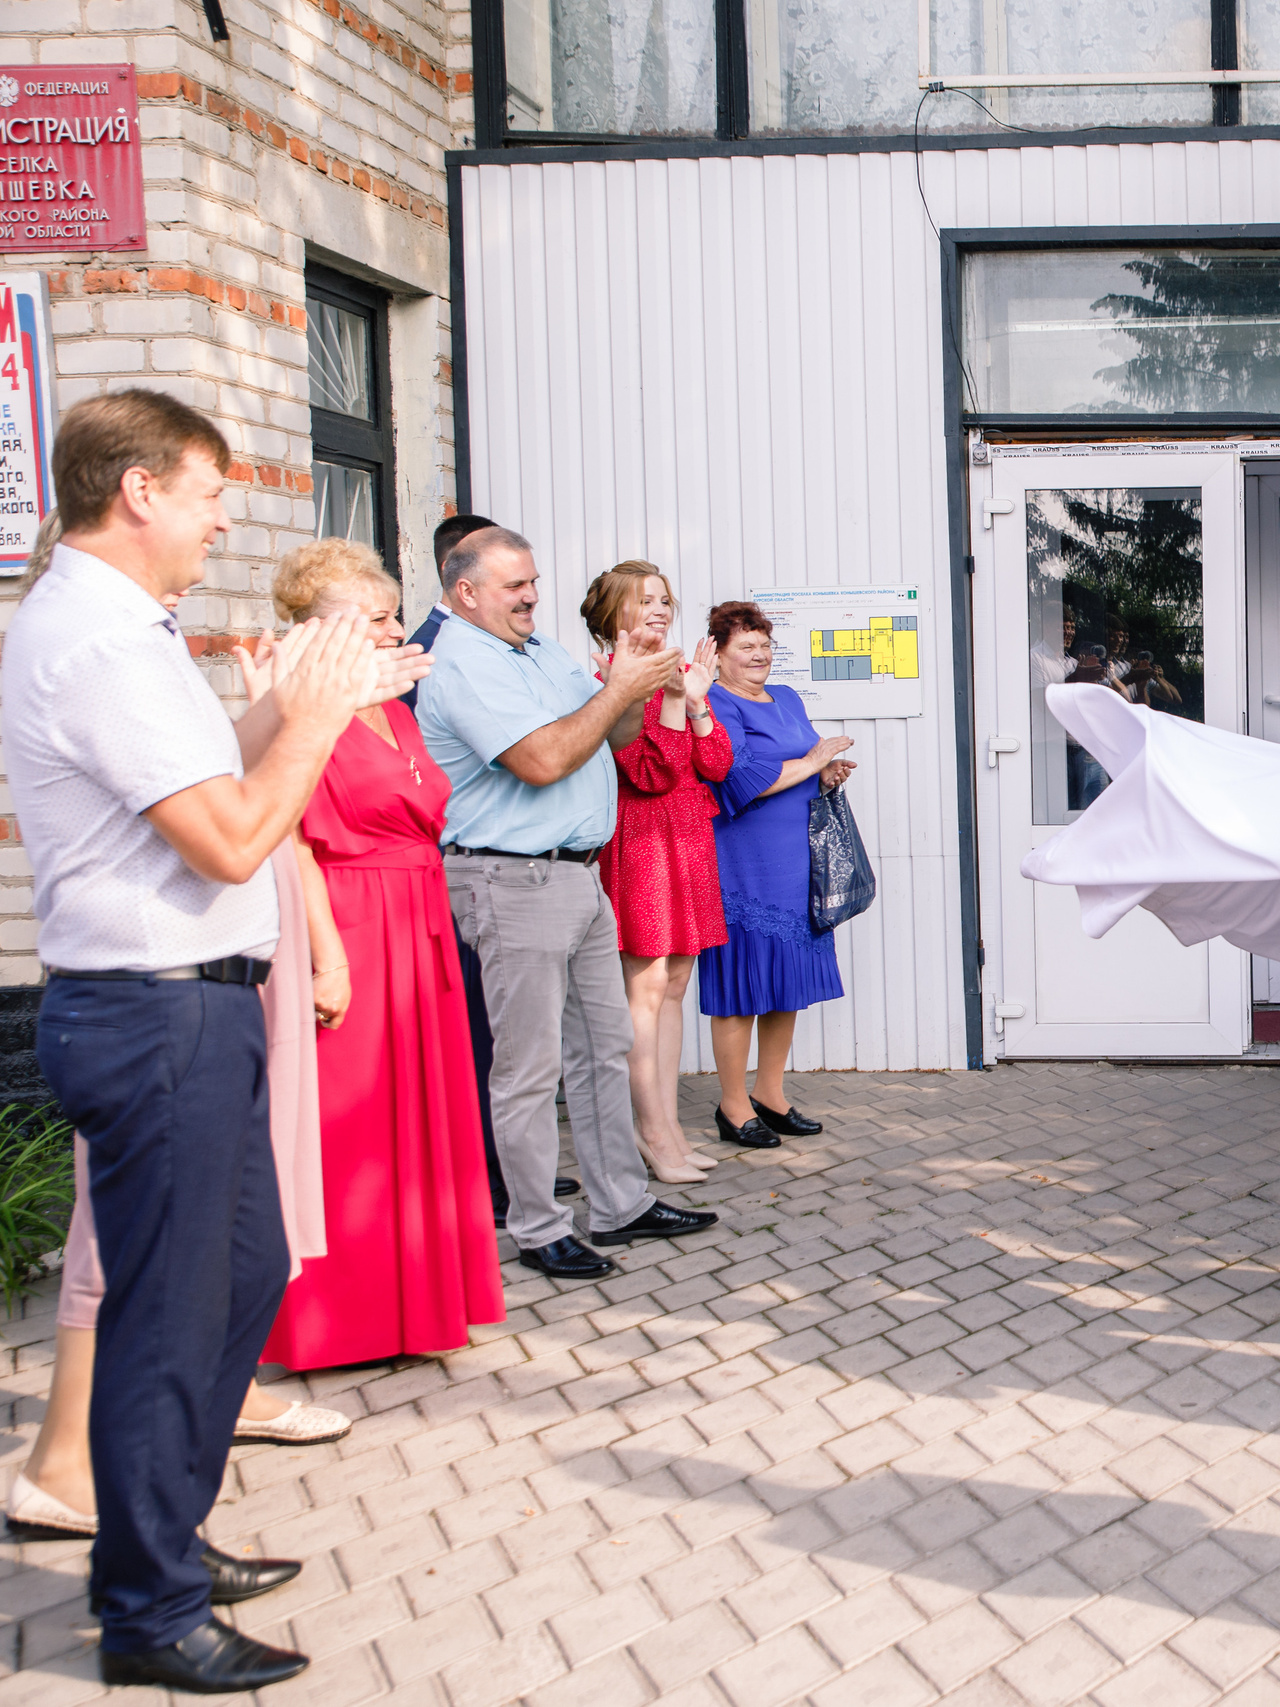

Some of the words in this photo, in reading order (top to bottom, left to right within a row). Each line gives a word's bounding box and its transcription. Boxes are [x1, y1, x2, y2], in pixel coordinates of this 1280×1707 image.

[24, 81, 109, 96] ФЕДЕРАЦИЯ
[52, 206, 110, 221] РАЙОНА
[25, 225, 91, 238] ОБЛАСТИ
[0, 501, 37, 515] КОГО,
